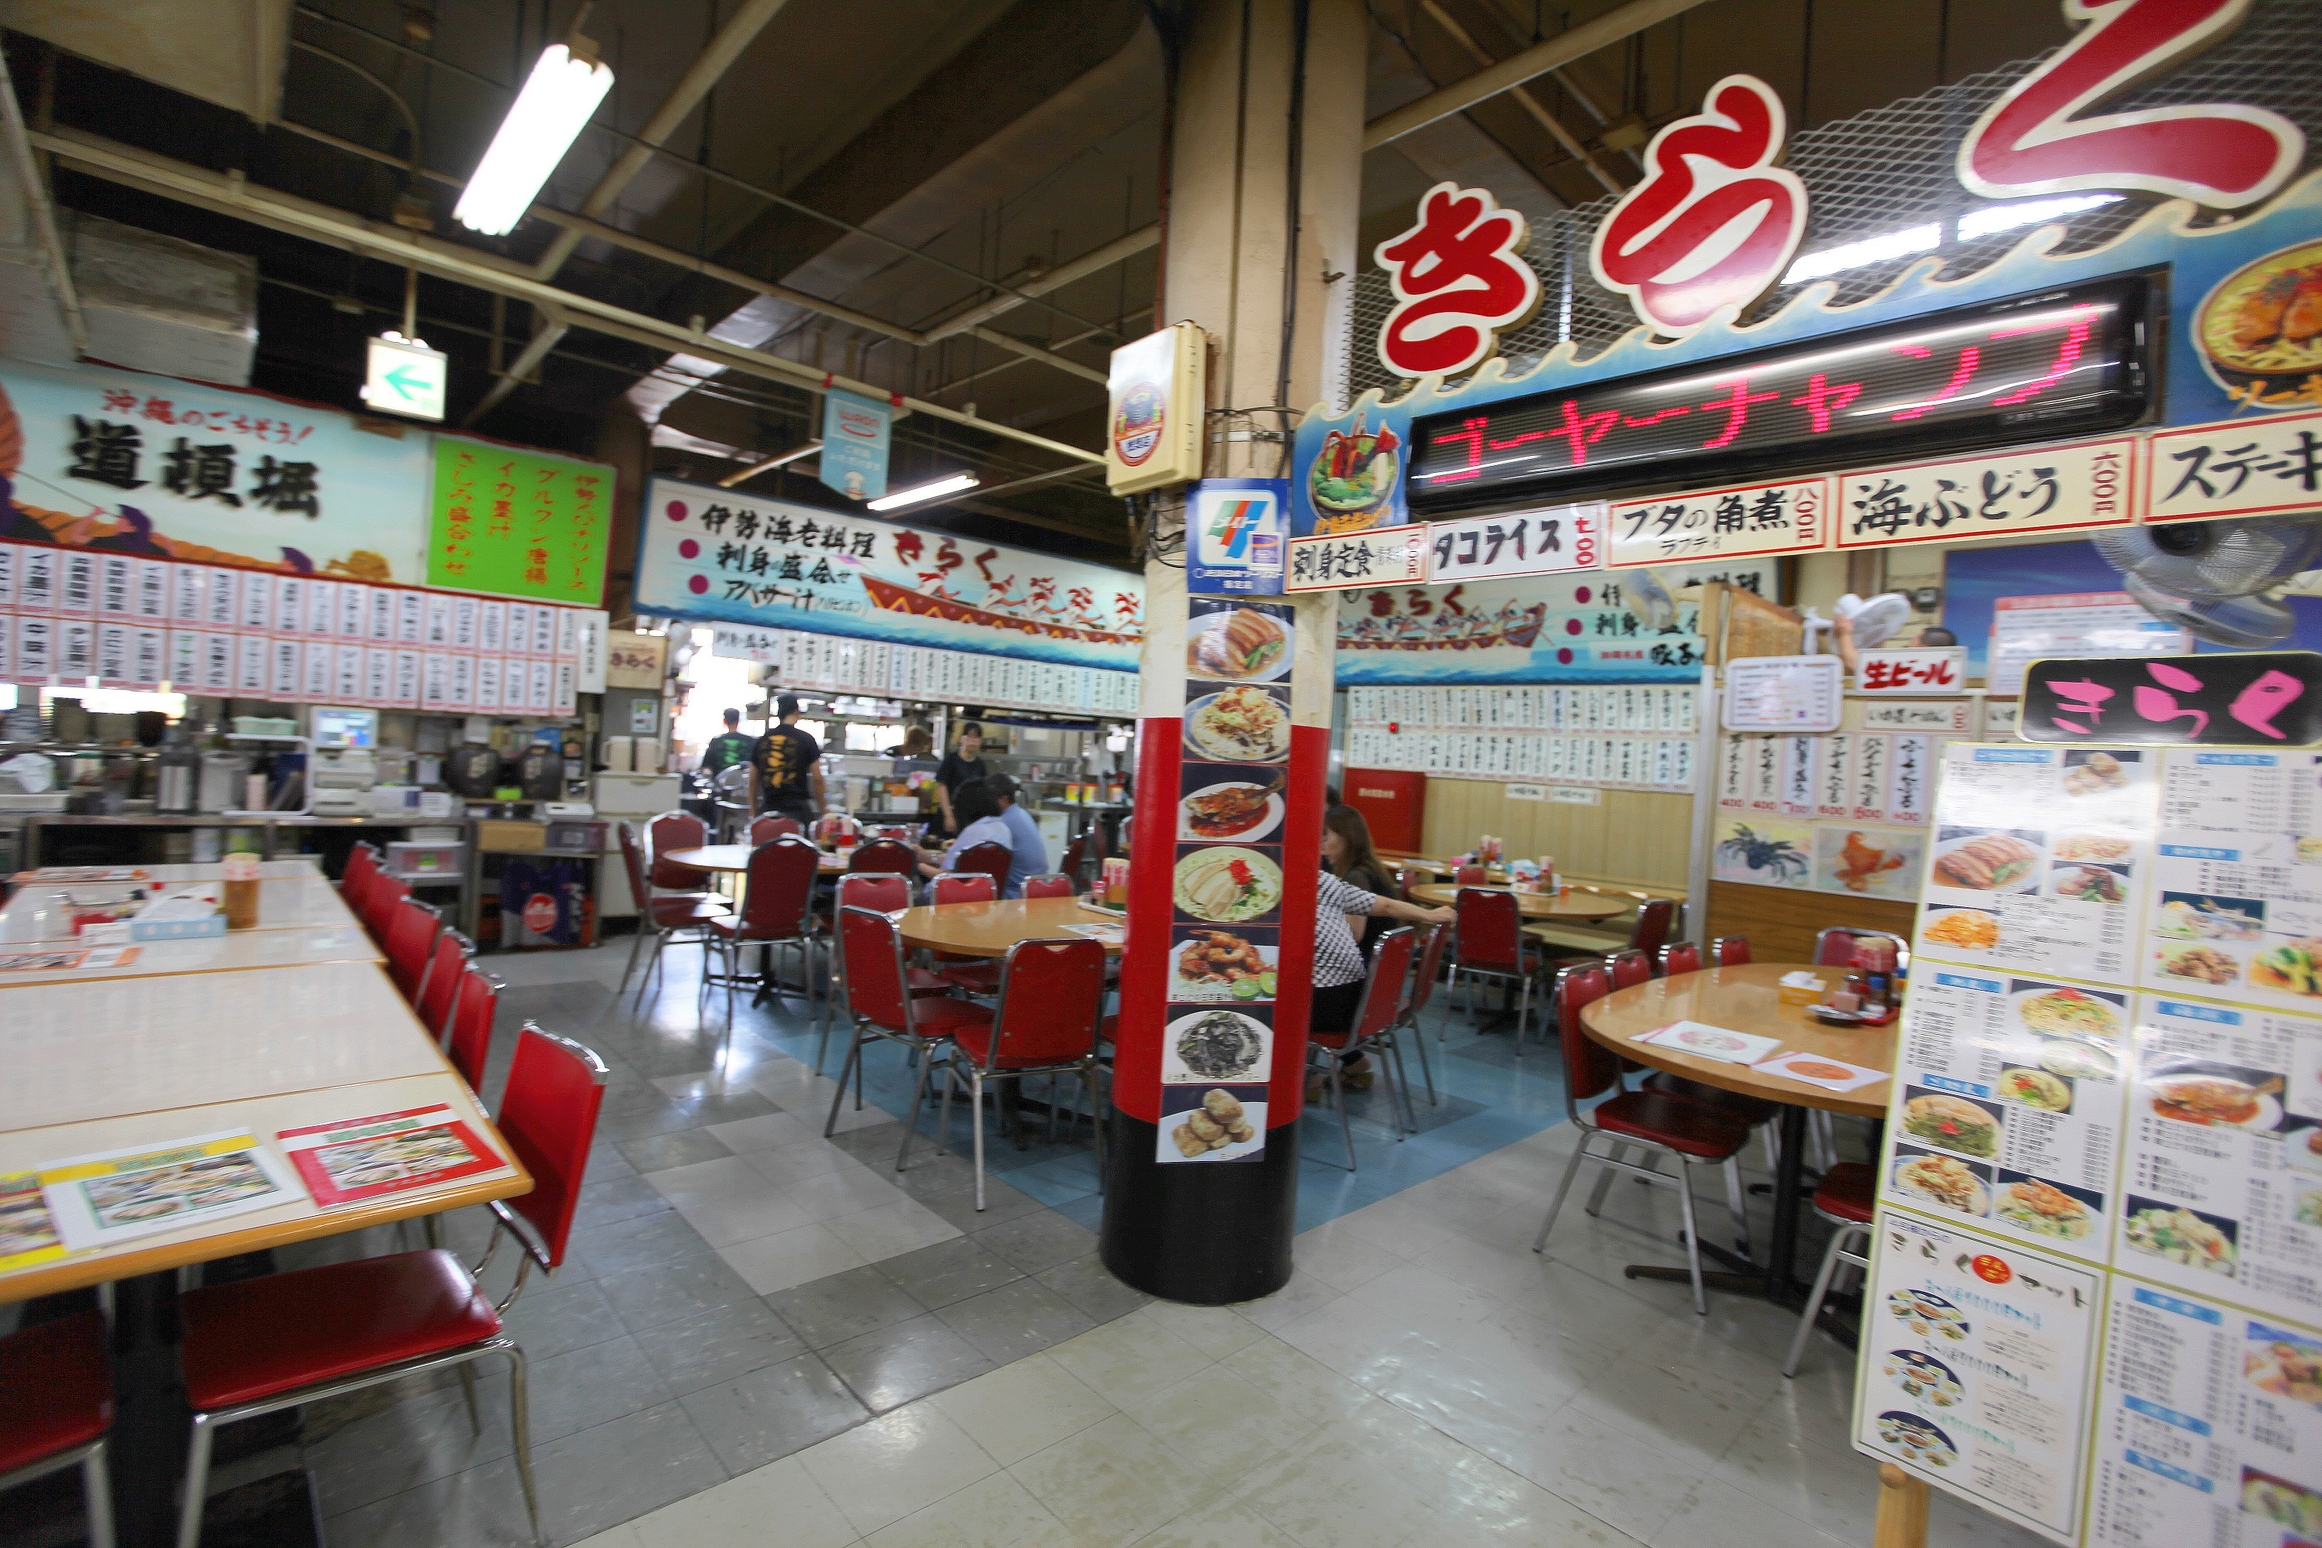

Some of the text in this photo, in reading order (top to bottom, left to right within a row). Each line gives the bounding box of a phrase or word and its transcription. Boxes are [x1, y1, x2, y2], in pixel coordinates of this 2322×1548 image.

[1374, 0, 2306, 380] きらく
[65, 414, 321, 519] 道頓堀
[1622, 489, 1789, 541] ブタの角煮
[1851, 466, 2060, 538] 海ぶどう
[700, 503, 877, 559] 伊勢海老料理
[892, 528, 999, 582] きらく
[1434, 519, 1561, 570] タコライス
[1293, 540, 1375, 582] 刺身定食
[1366, 584, 1465, 618] きらく
[1864, 659, 1956, 689] 生ビール
[2045, 662, 2305, 740] きらく
